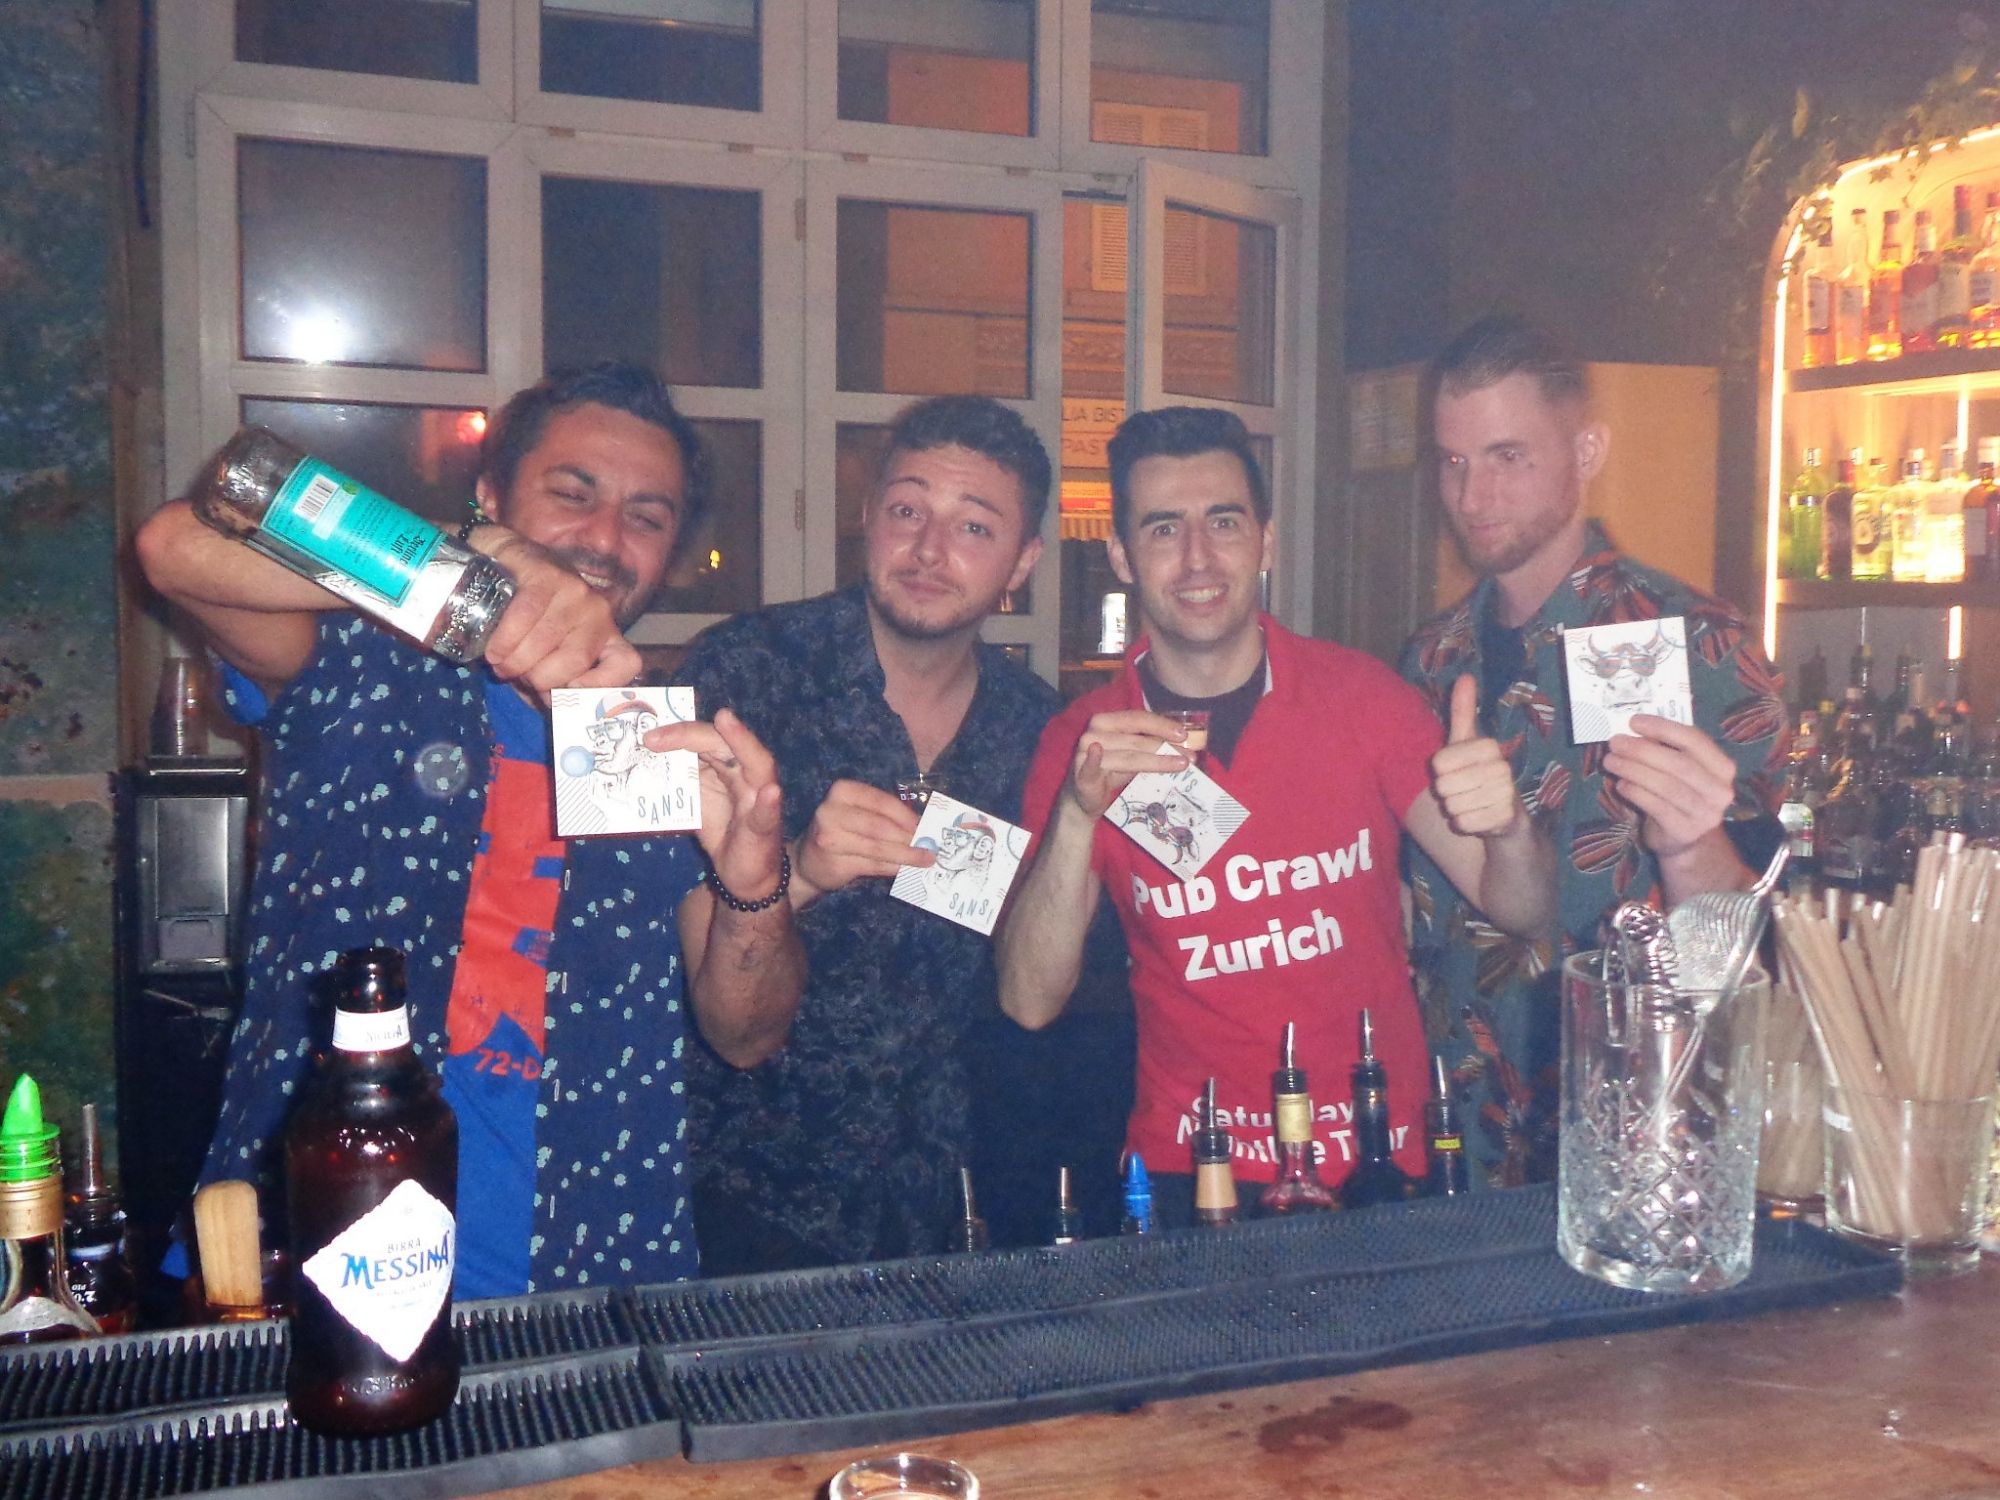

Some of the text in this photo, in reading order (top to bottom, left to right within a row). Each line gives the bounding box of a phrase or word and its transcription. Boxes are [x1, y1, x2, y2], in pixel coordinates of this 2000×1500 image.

[637, 786, 694, 825] SANSI
[1131, 828, 1373, 919] Pub Crawl
[948, 892, 995, 924] SANSI
[1178, 908, 1344, 981] Zurich
[340, 1229, 450, 1290] MESSINA
[387, 1237, 421, 1254] BIRRA
